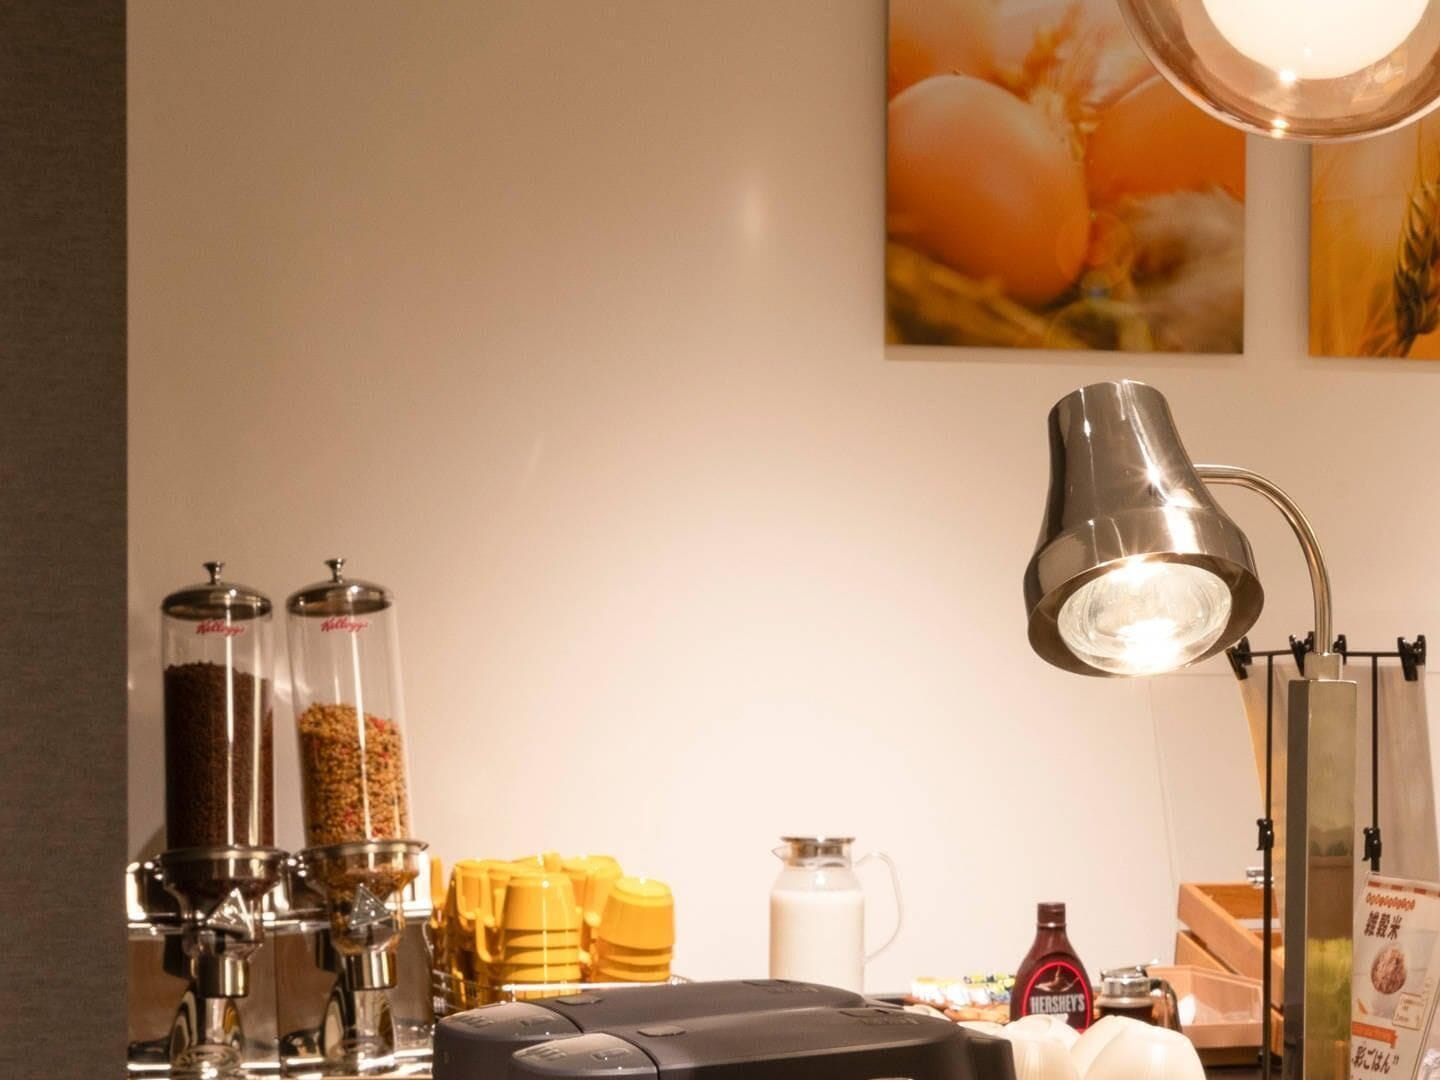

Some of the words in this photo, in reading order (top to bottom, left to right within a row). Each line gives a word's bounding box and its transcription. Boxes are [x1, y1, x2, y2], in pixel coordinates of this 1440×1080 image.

[1364, 910, 1402, 940] 雑穀米
[1030, 993, 1086, 1014] HERSHEY'S
